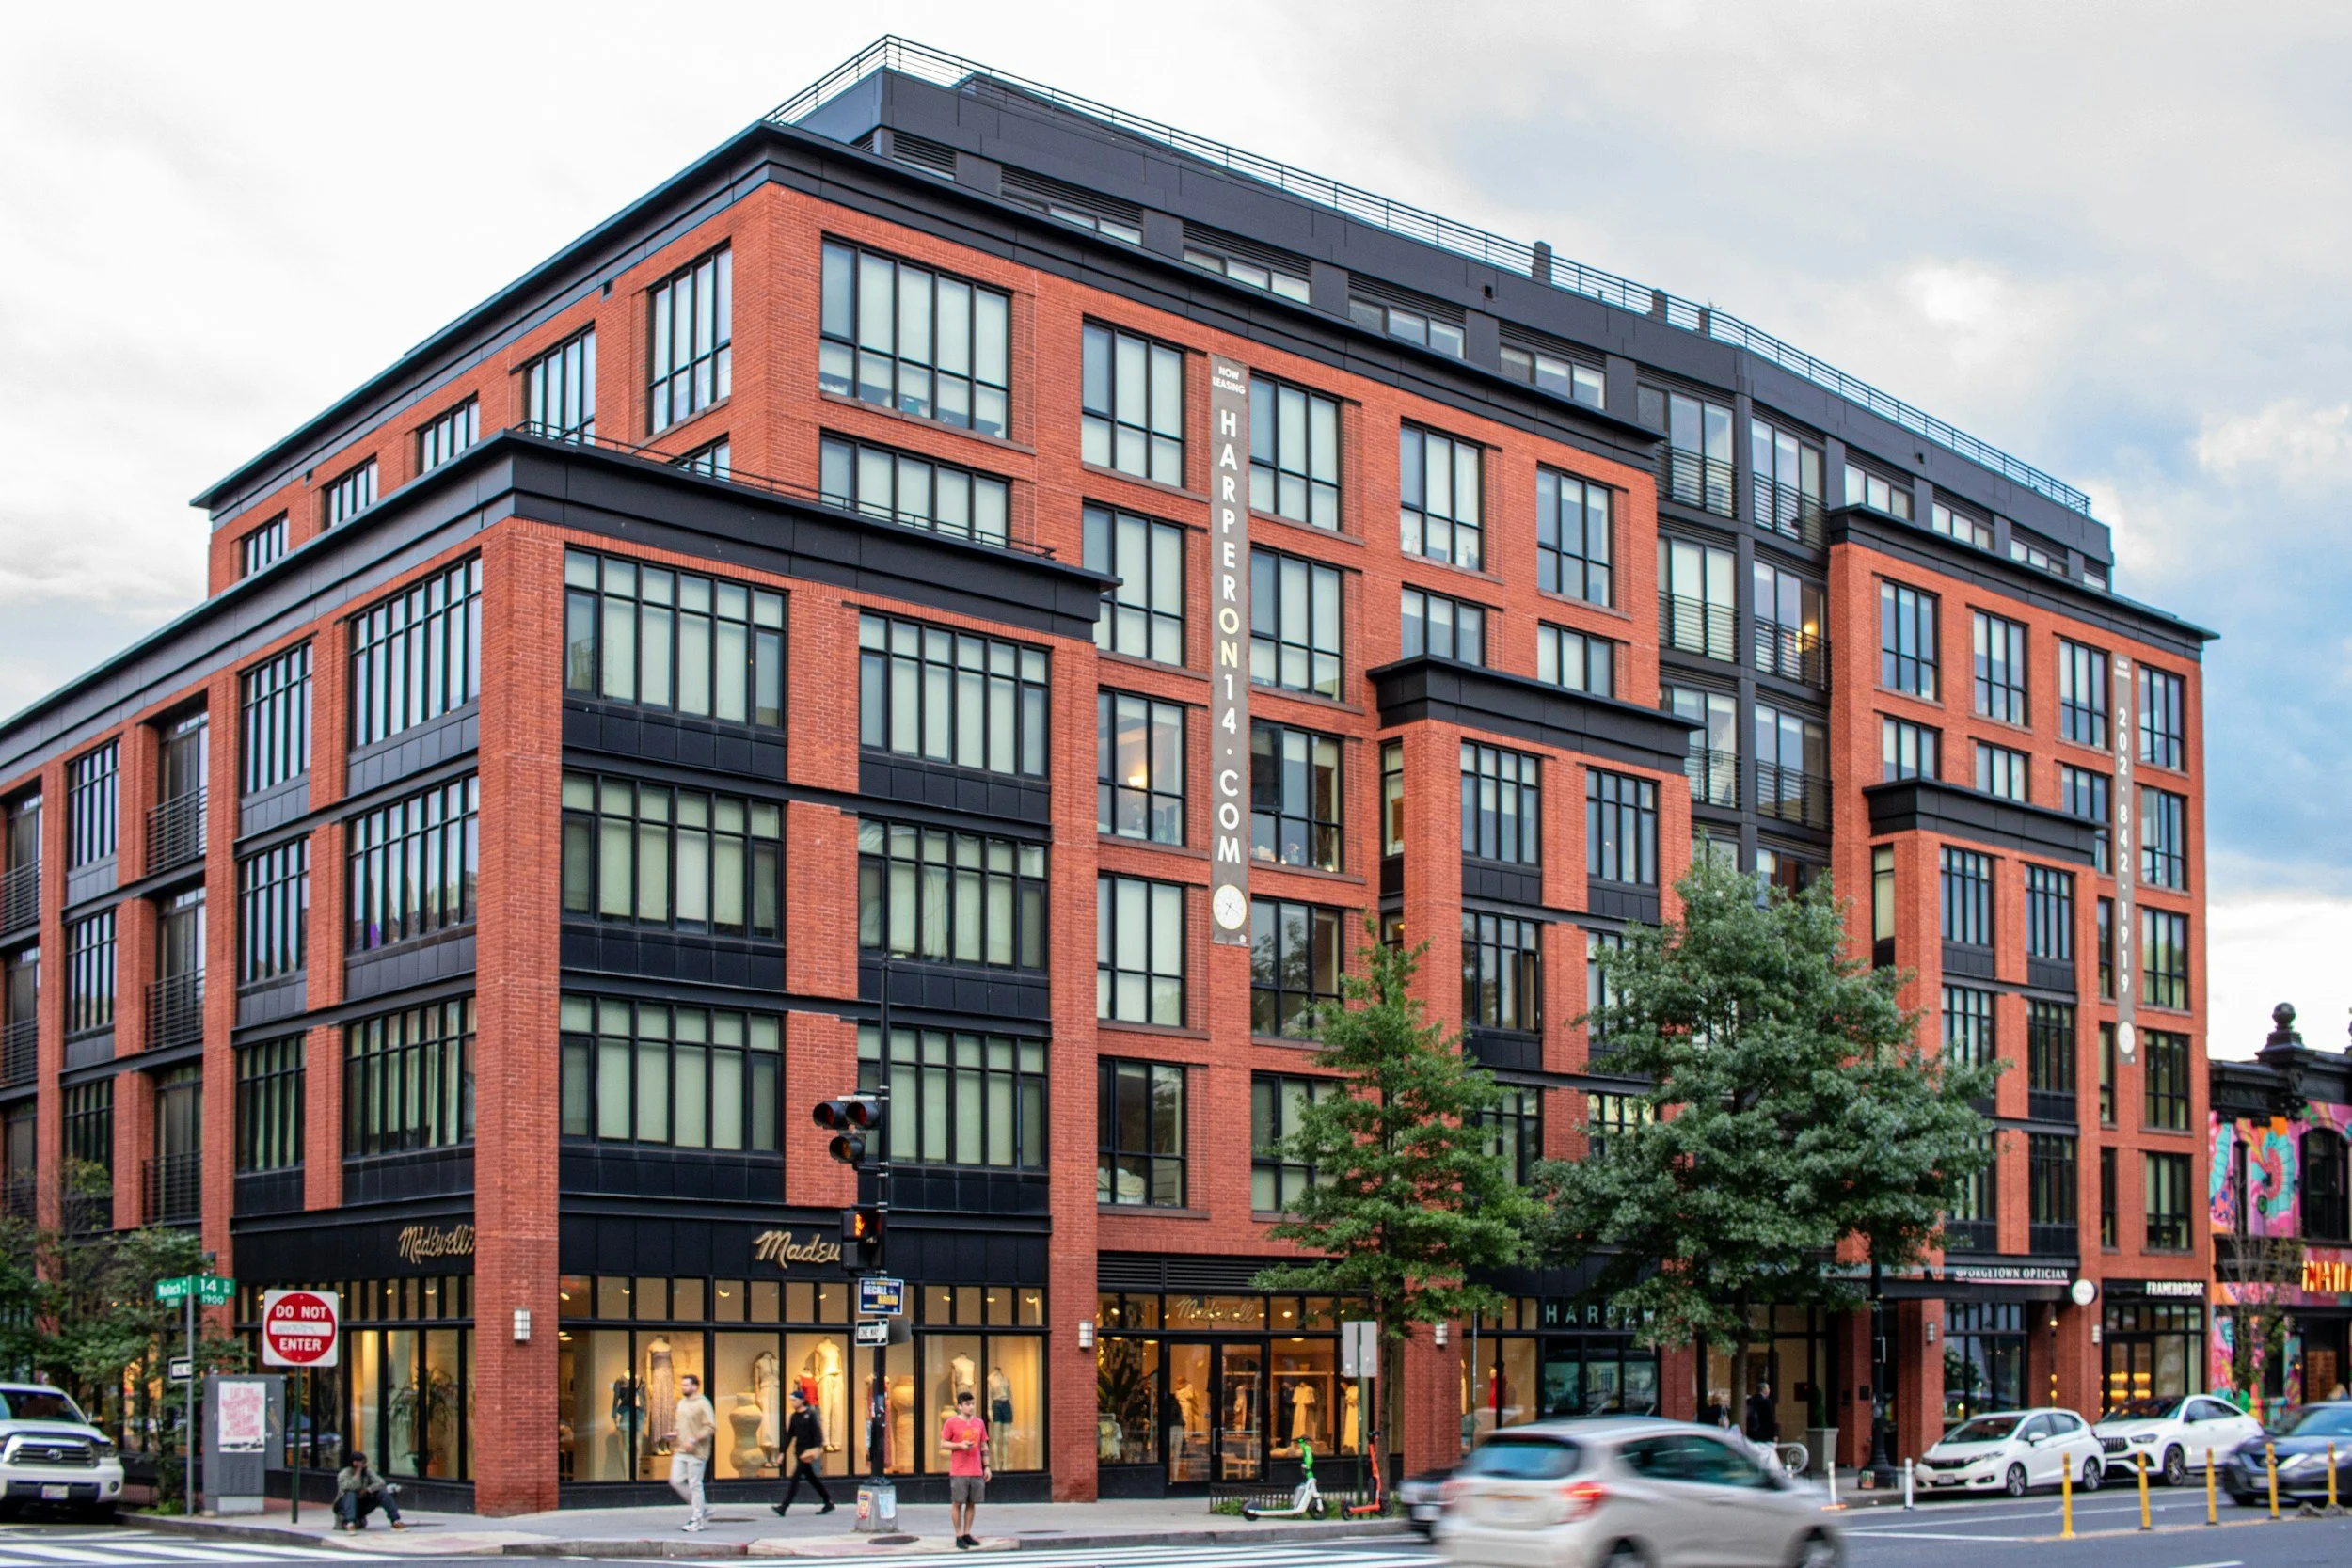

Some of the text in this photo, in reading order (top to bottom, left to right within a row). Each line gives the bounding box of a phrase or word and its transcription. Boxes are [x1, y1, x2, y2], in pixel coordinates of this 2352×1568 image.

[1218, 366, 1239, 380] NOW
[1213, 376, 1246, 394] LEASING
[2023, 1269, 2068, 1280] OPTICIAN
[200, 1278, 217, 1293] 14
[202, 1295, 225, 1305] 1900
[275, 1304, 327, 1319] DO NOT
[279, 1338, 322, 1352] ENTER
